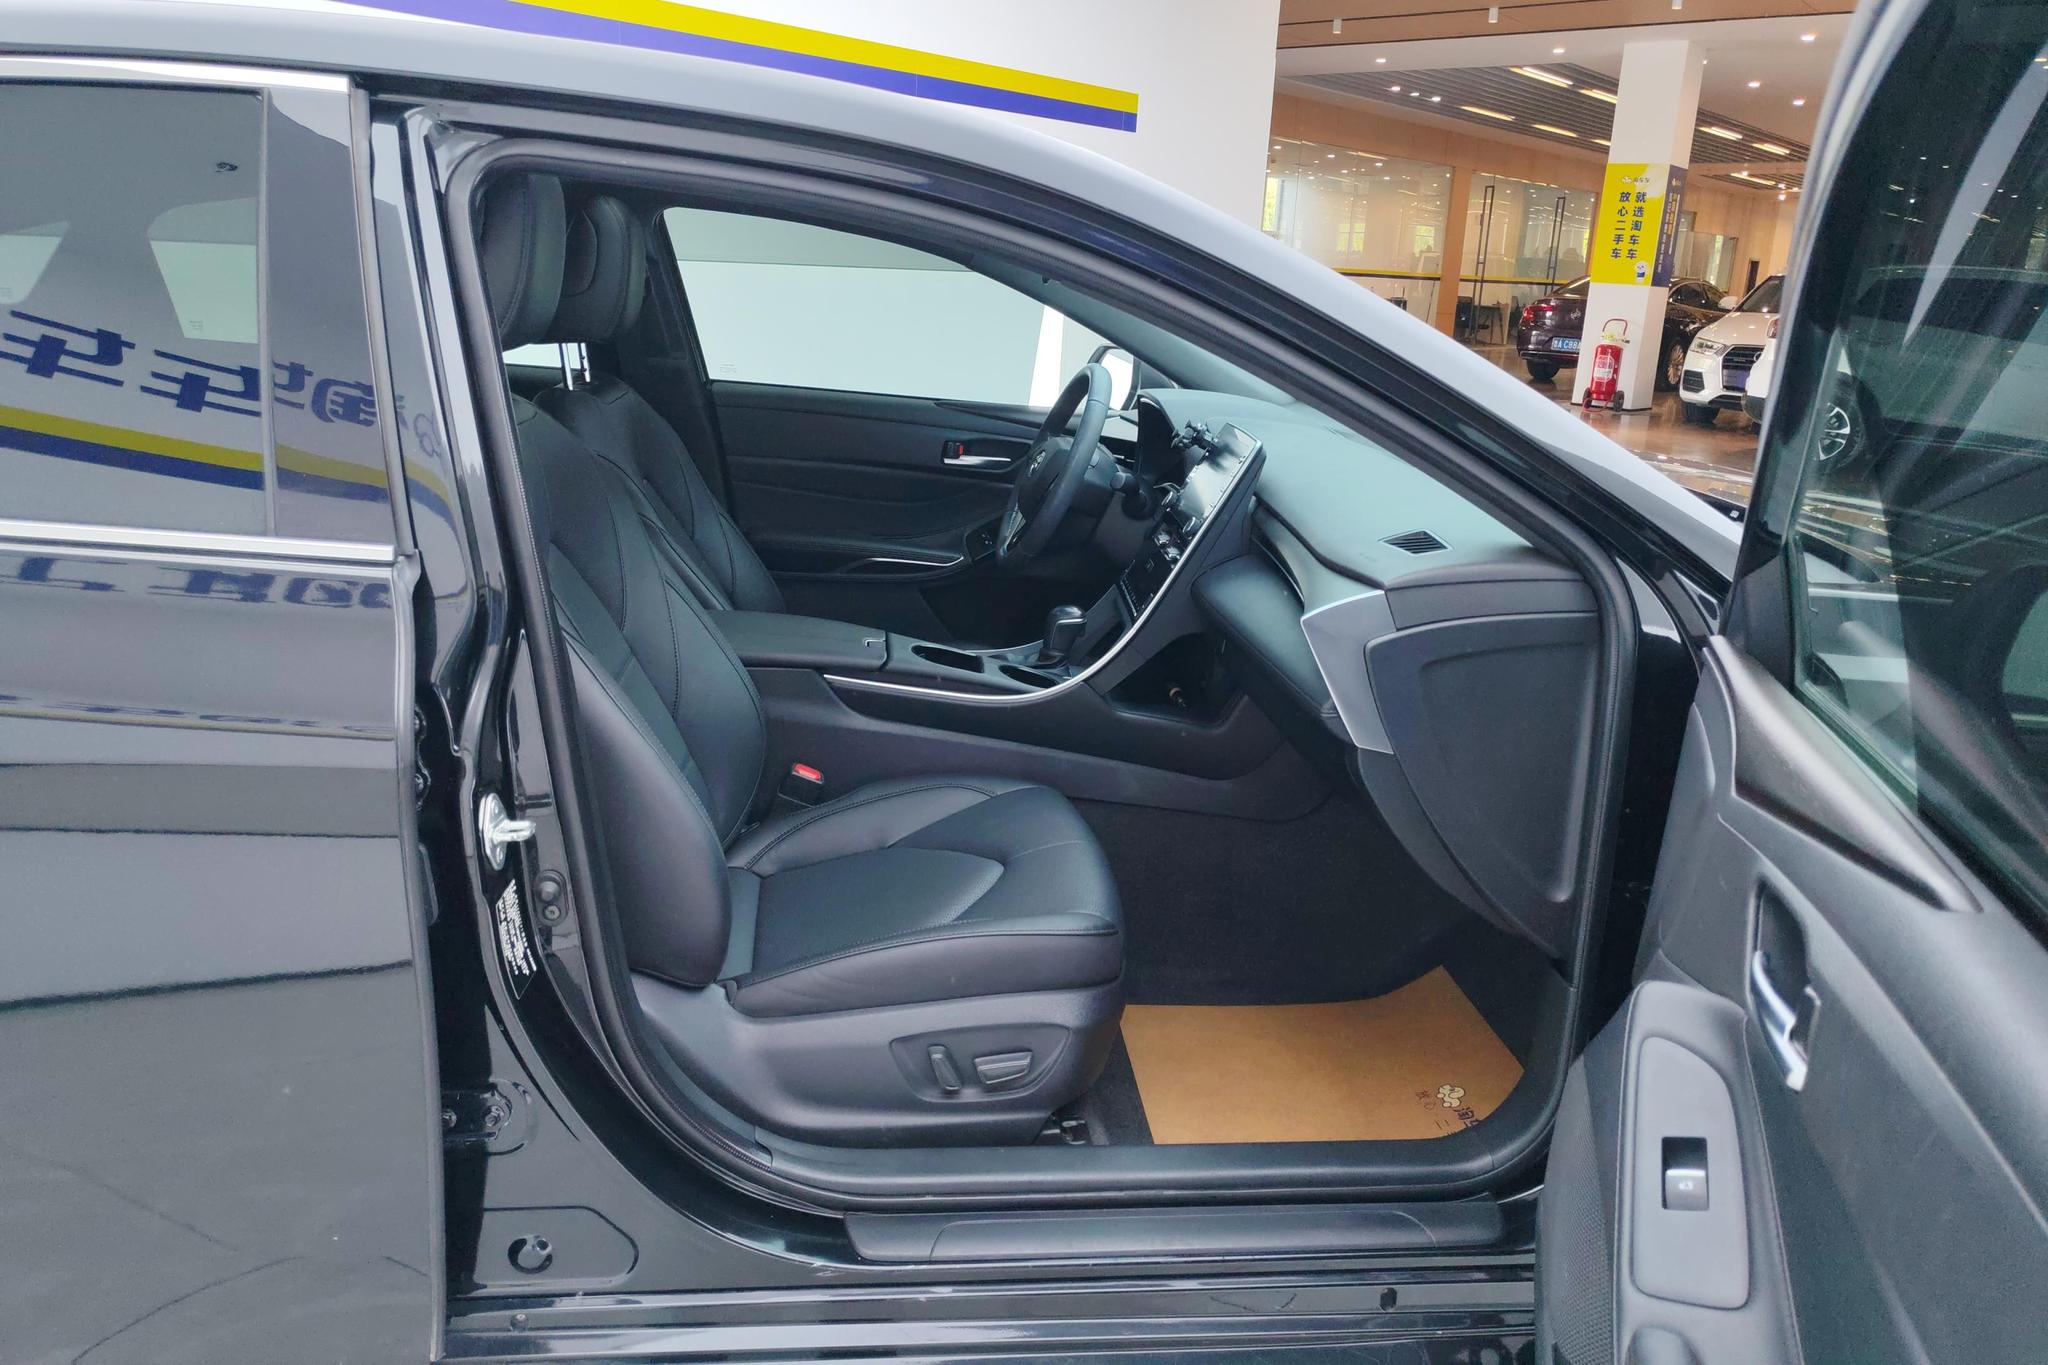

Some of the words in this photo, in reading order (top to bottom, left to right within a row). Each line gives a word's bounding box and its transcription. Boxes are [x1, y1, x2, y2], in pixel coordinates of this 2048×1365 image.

[1611, 191, 1631, 259] 放心二手车
[1626, 191, 1647, 259] 就选淘车车
